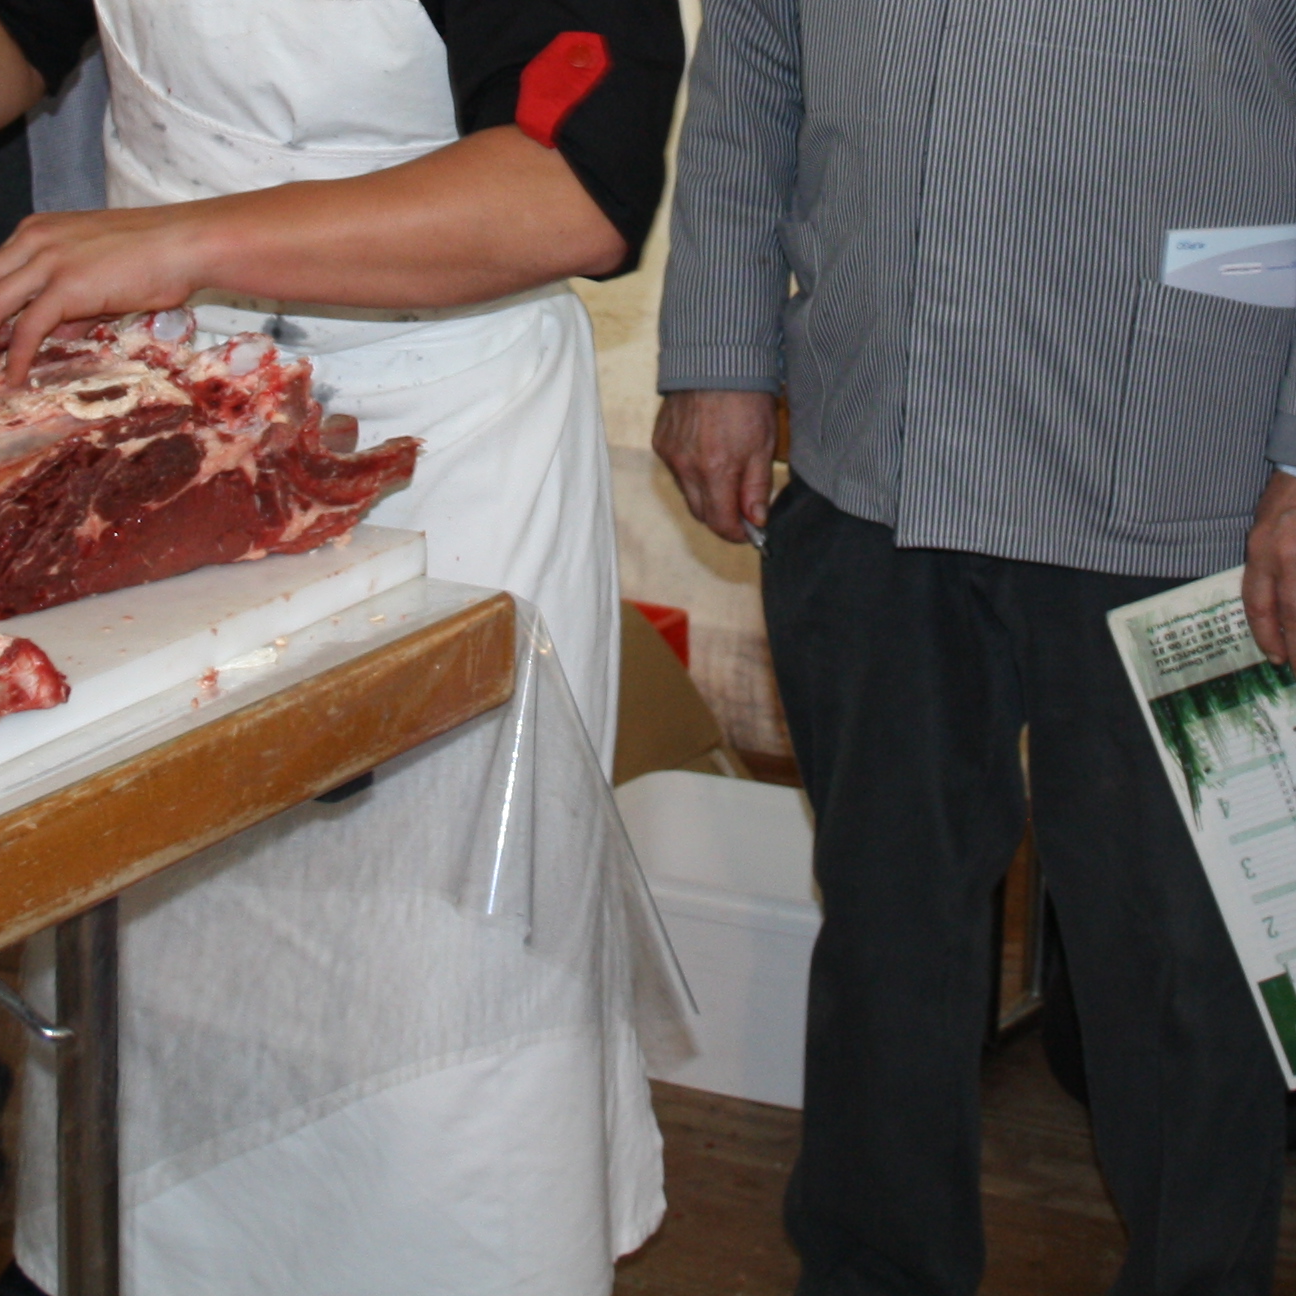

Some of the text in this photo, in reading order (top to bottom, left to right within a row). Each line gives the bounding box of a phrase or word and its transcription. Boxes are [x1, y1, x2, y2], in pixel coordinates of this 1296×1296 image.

[1216, 794, 1233, 819] 4
[1238, 856, 1257, 881] 3
[1260, 915, 1280, 940] 2
